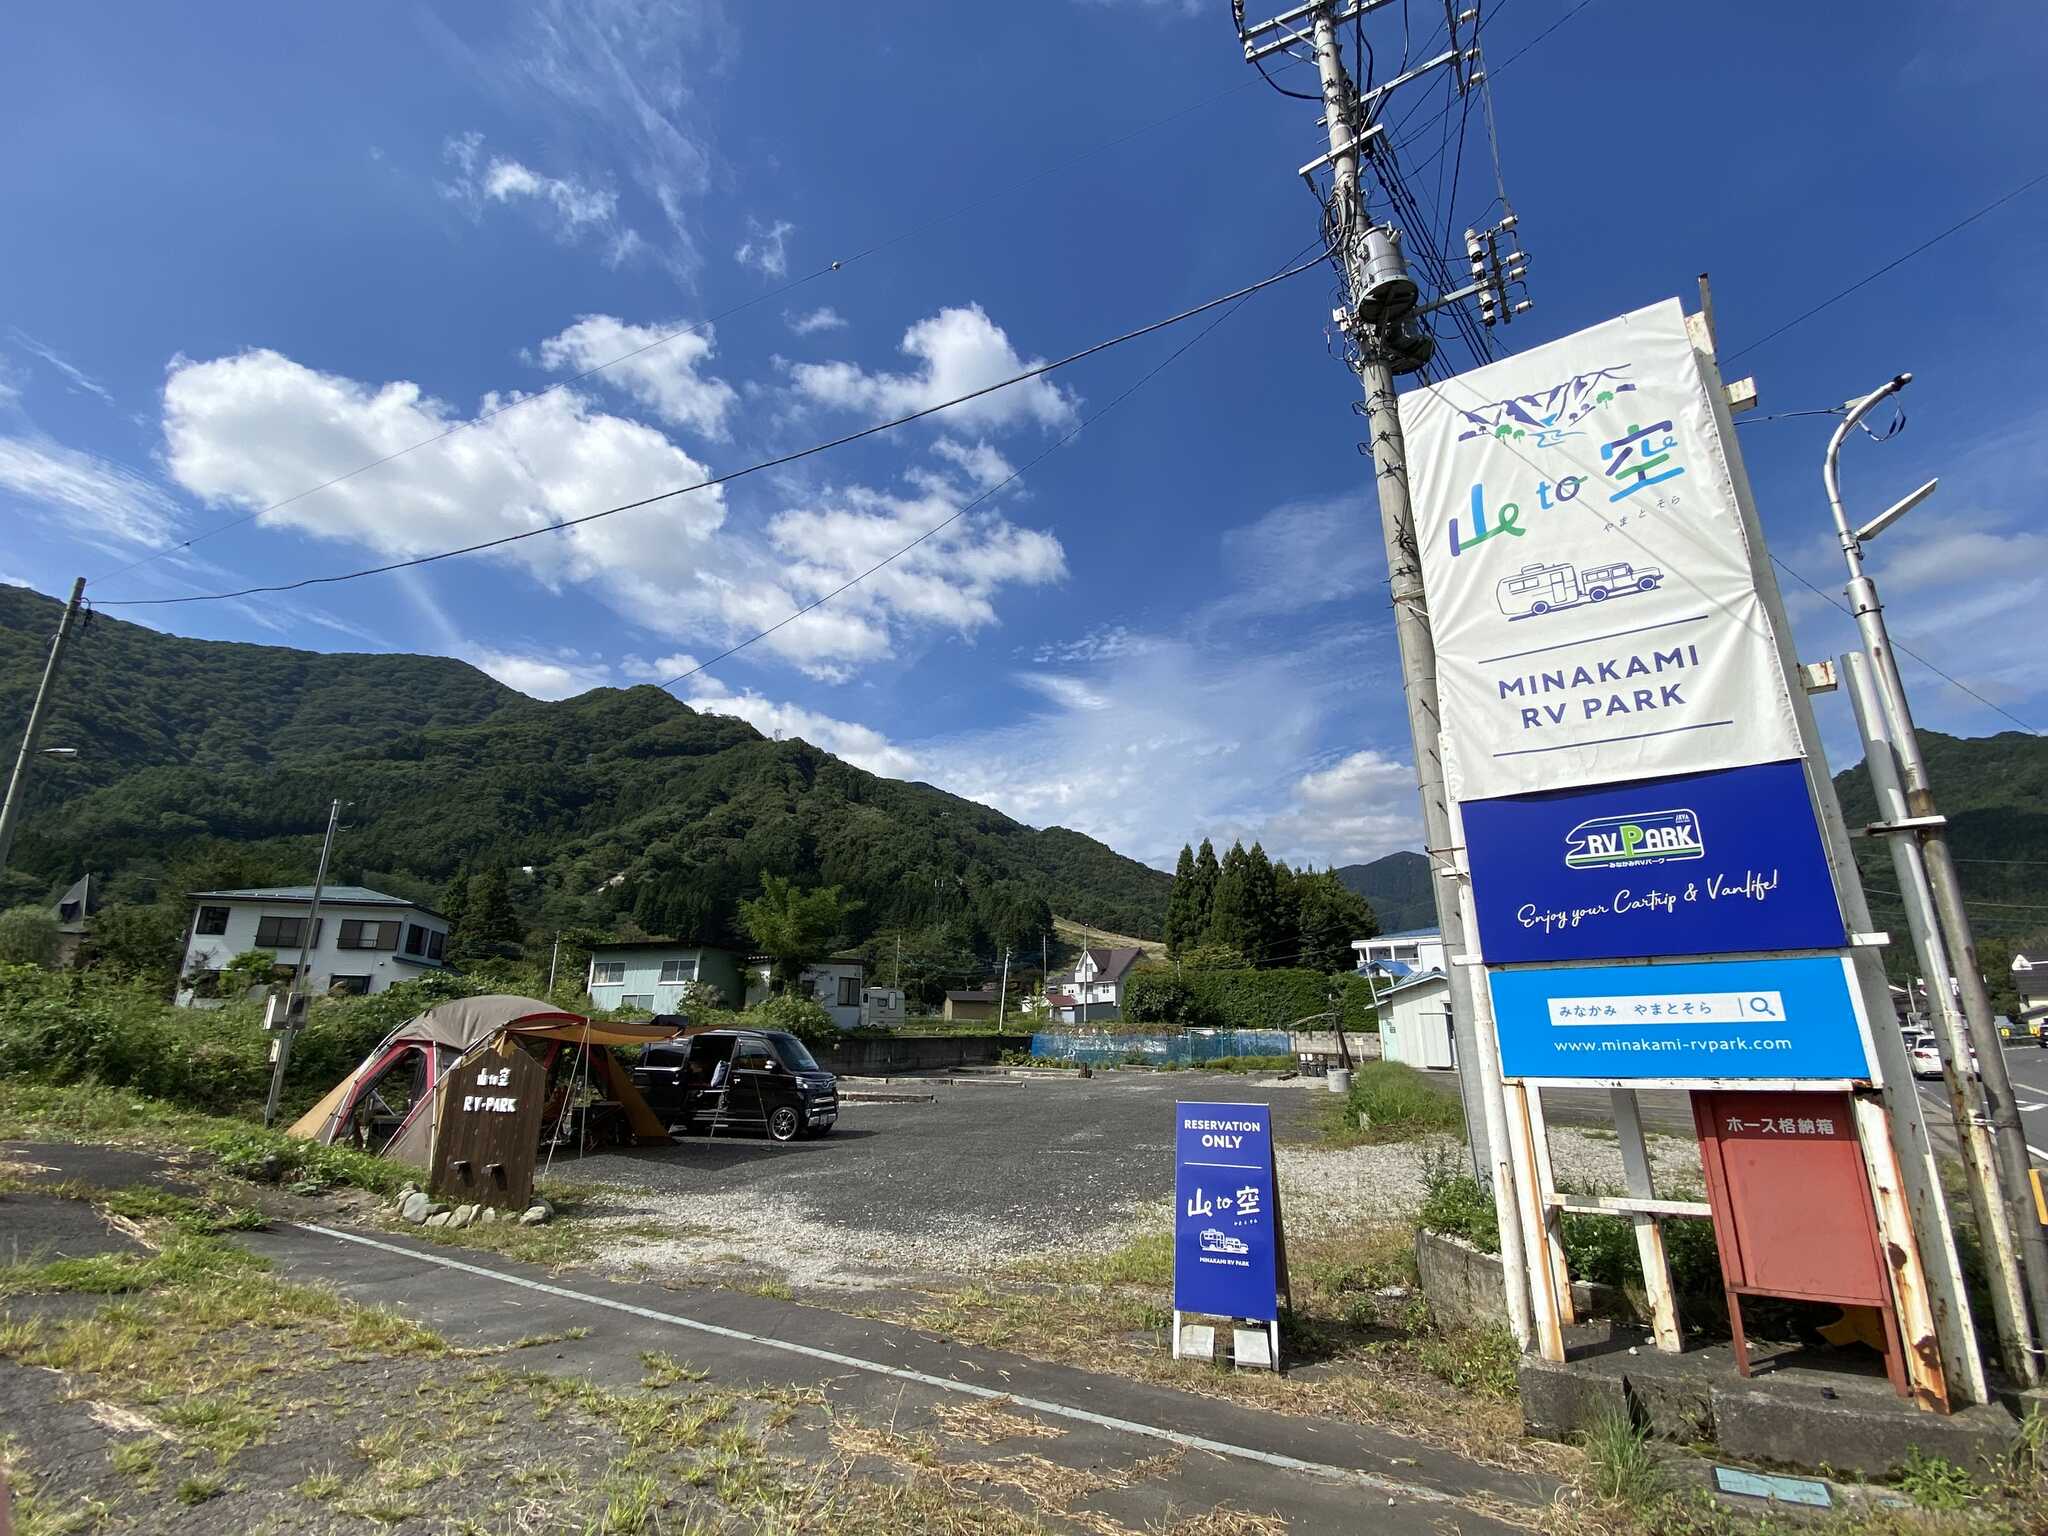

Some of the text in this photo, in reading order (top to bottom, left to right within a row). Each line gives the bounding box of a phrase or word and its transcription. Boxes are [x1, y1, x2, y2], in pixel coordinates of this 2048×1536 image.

[1536, 475, 1588, 510] to
[1498, 644, 1699, 699] MINAKAMI
[1520, 683, 1687, 729] RV PARK
[1517, 868, 1778, 934] Enjoy your Cartrip & Vanlife!
[1559, 1001, 1712, 1018] みなかみ やまとそら
[1554, 1037, 1793, 1053] www.minakami-rvpark.com
[1184, 1119, 1261, 1132] RESERVATION
[1726, 1116, 1835, 1135] ホース格納箱
[1201, 1134, 1243, 1149] ONLY
[1216, 1196, 1233, 1210] to
